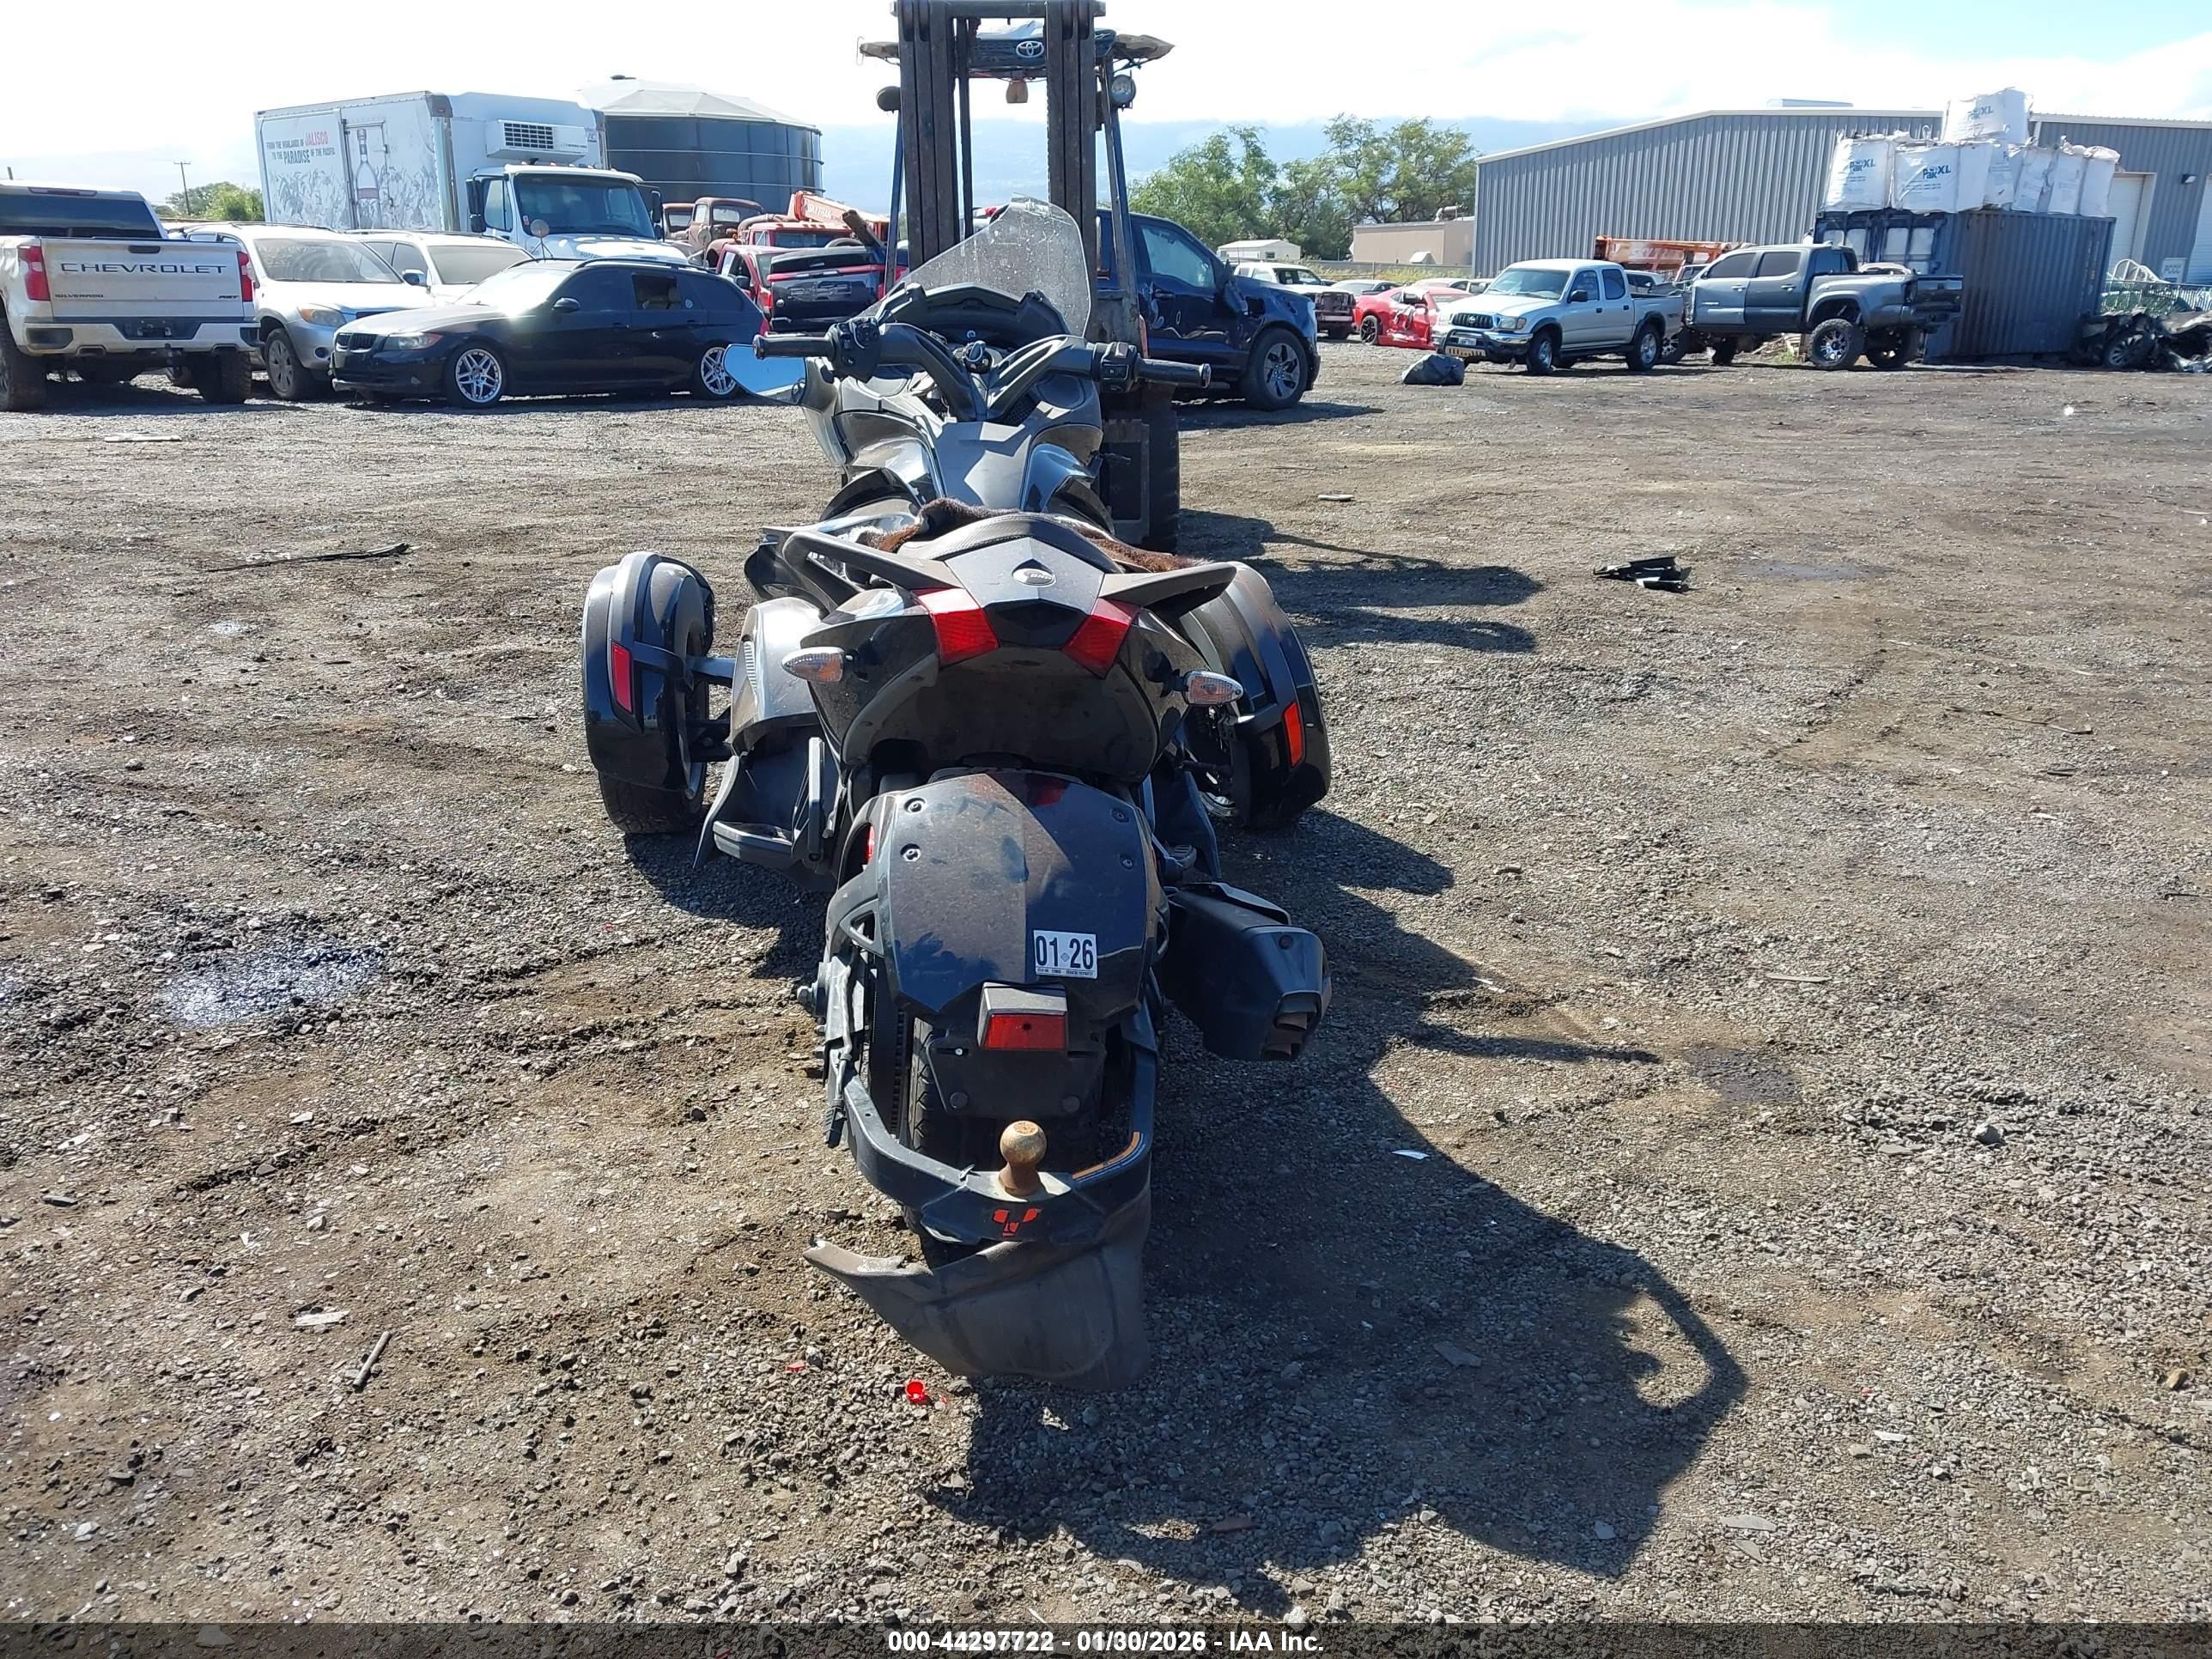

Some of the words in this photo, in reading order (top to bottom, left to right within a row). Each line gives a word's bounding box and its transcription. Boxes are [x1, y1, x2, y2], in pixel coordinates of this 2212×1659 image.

[305, 131, 328, 146] JALISCO
[283, 149, 310, 165] PARADISE
[61, 263, 227, 274] CHEVROLET
[1036, 936, 1059, 967] 01
[1069, 938, 1094, 969] 26
